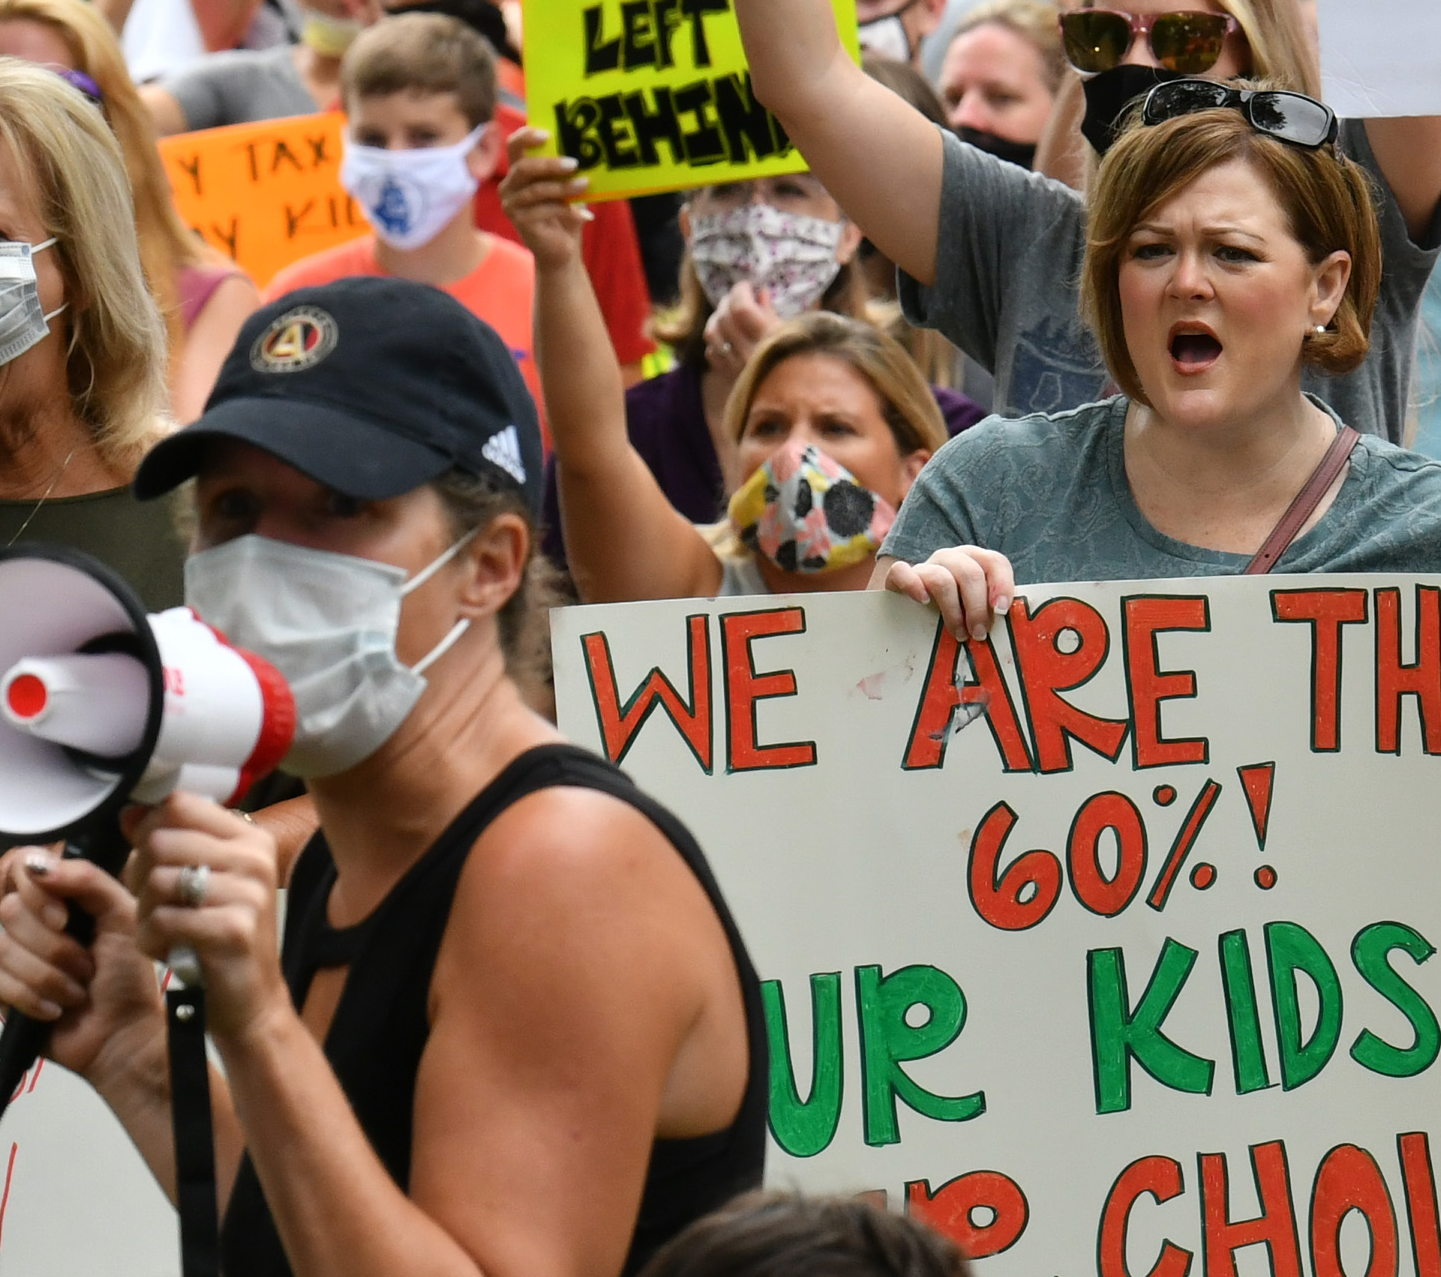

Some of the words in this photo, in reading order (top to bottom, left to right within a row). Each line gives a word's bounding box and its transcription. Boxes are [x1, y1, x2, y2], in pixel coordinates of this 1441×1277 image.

[580, 607, 818, 775] WE
[900, 594, 1211, 776] ARE
[966, 762, 1277, 932] 60%!
